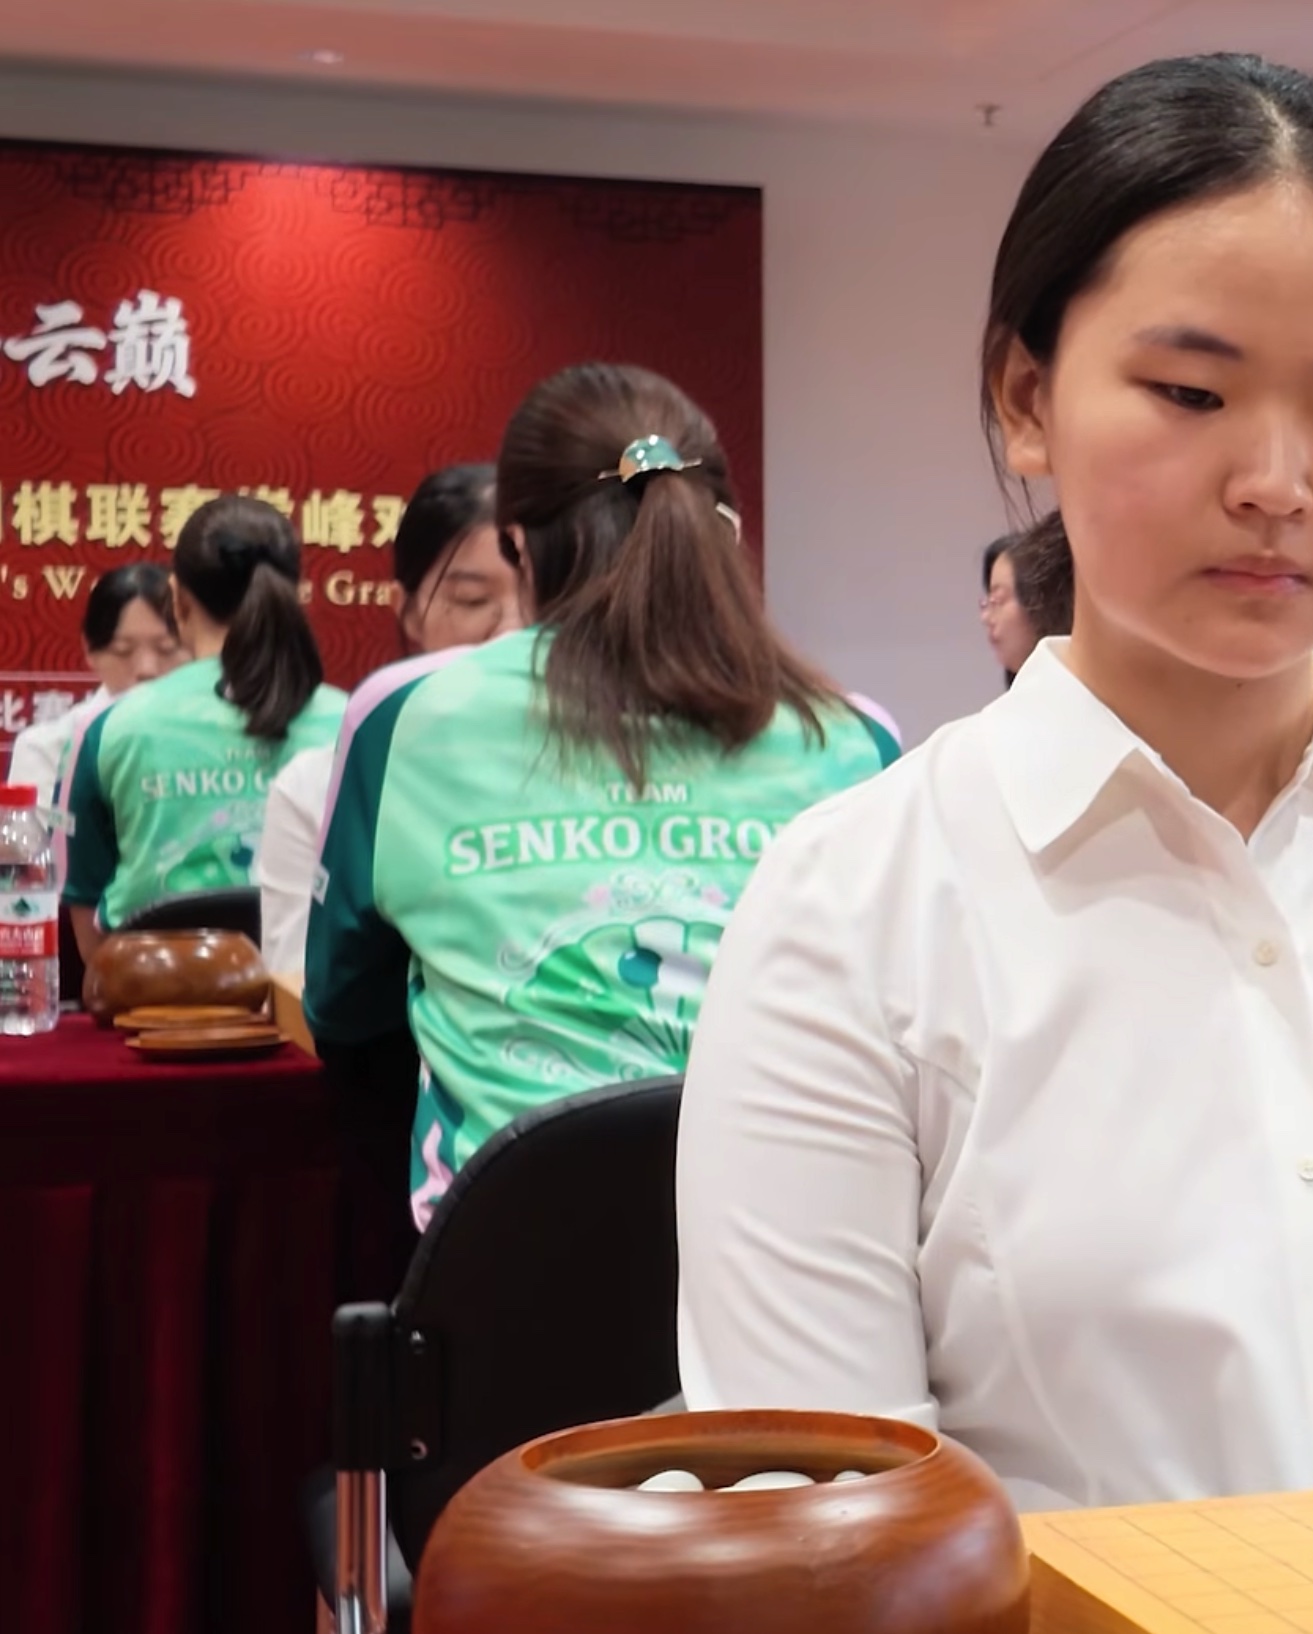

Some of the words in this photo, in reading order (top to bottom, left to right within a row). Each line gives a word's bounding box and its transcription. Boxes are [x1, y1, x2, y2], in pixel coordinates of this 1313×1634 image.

[3, 288, 196, 398] 云巅
[326, 569, 398, 606] Gra
[449, 816, 641, 874] SENKO
[659, 815, 788, 860] GRO
